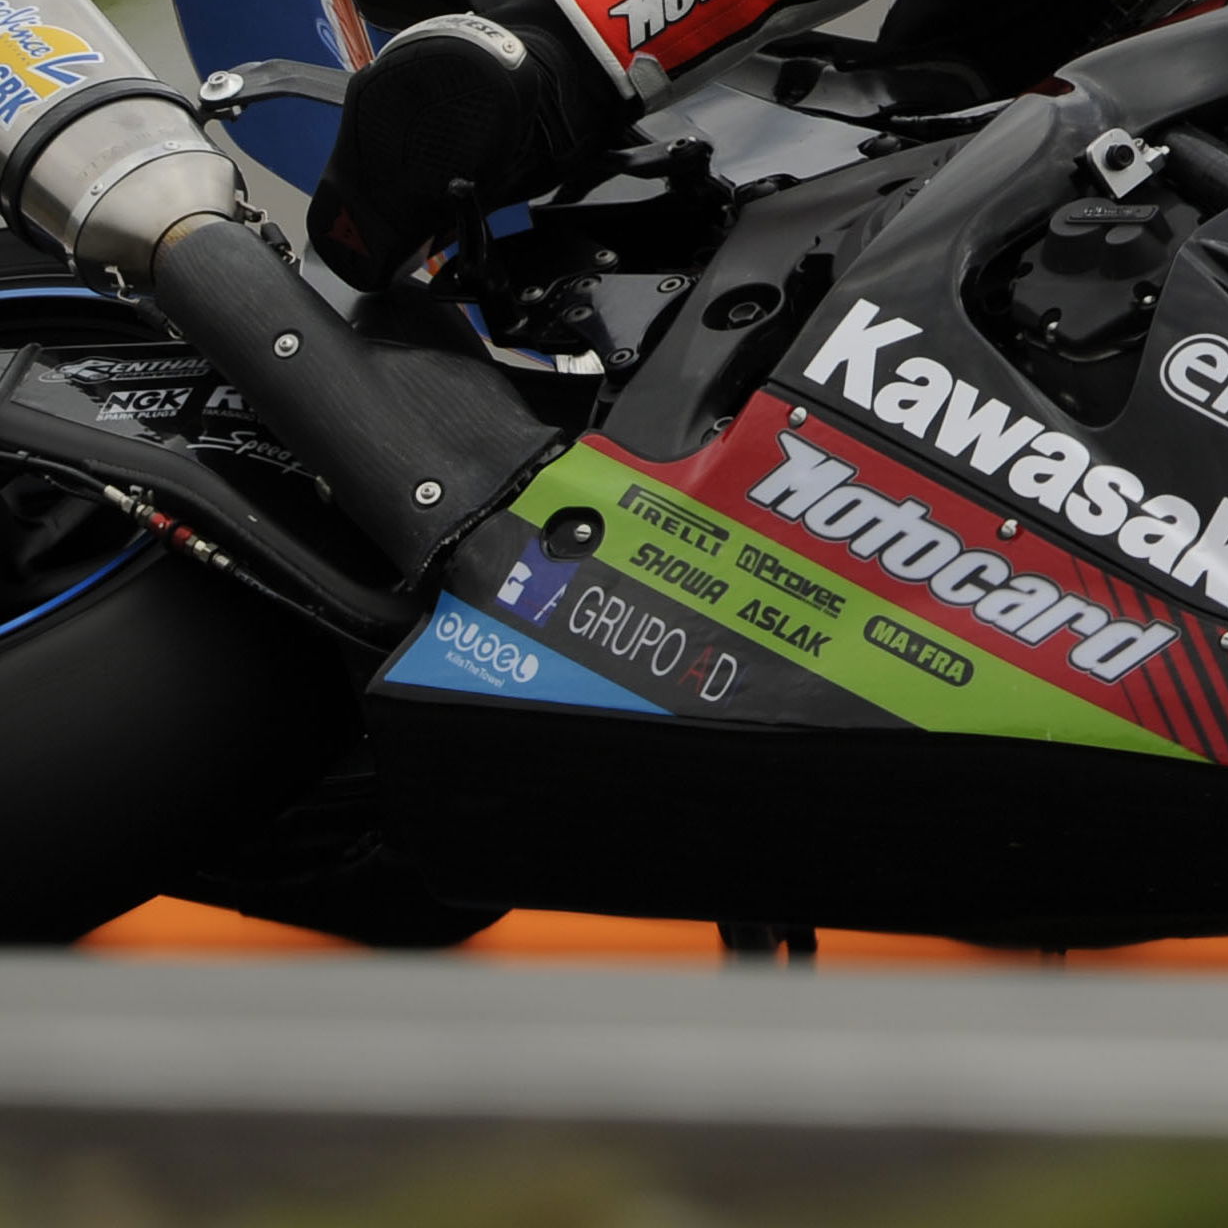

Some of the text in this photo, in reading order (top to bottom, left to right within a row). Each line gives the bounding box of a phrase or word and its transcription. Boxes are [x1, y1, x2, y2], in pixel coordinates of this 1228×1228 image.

[105, 389, 191, 413] NGK
[137, 409, 177, 420] PLUGS
[617, 484, 730, 557] PIRELLI
[629, 542, 729, 605] SHOWA
[748, 430, 1180, 684] Motocard
[750, 548, 847, 615] Provec
[568, 585, 687, 677] GRUPO
[736, 598, 832, 659] ASLAK
